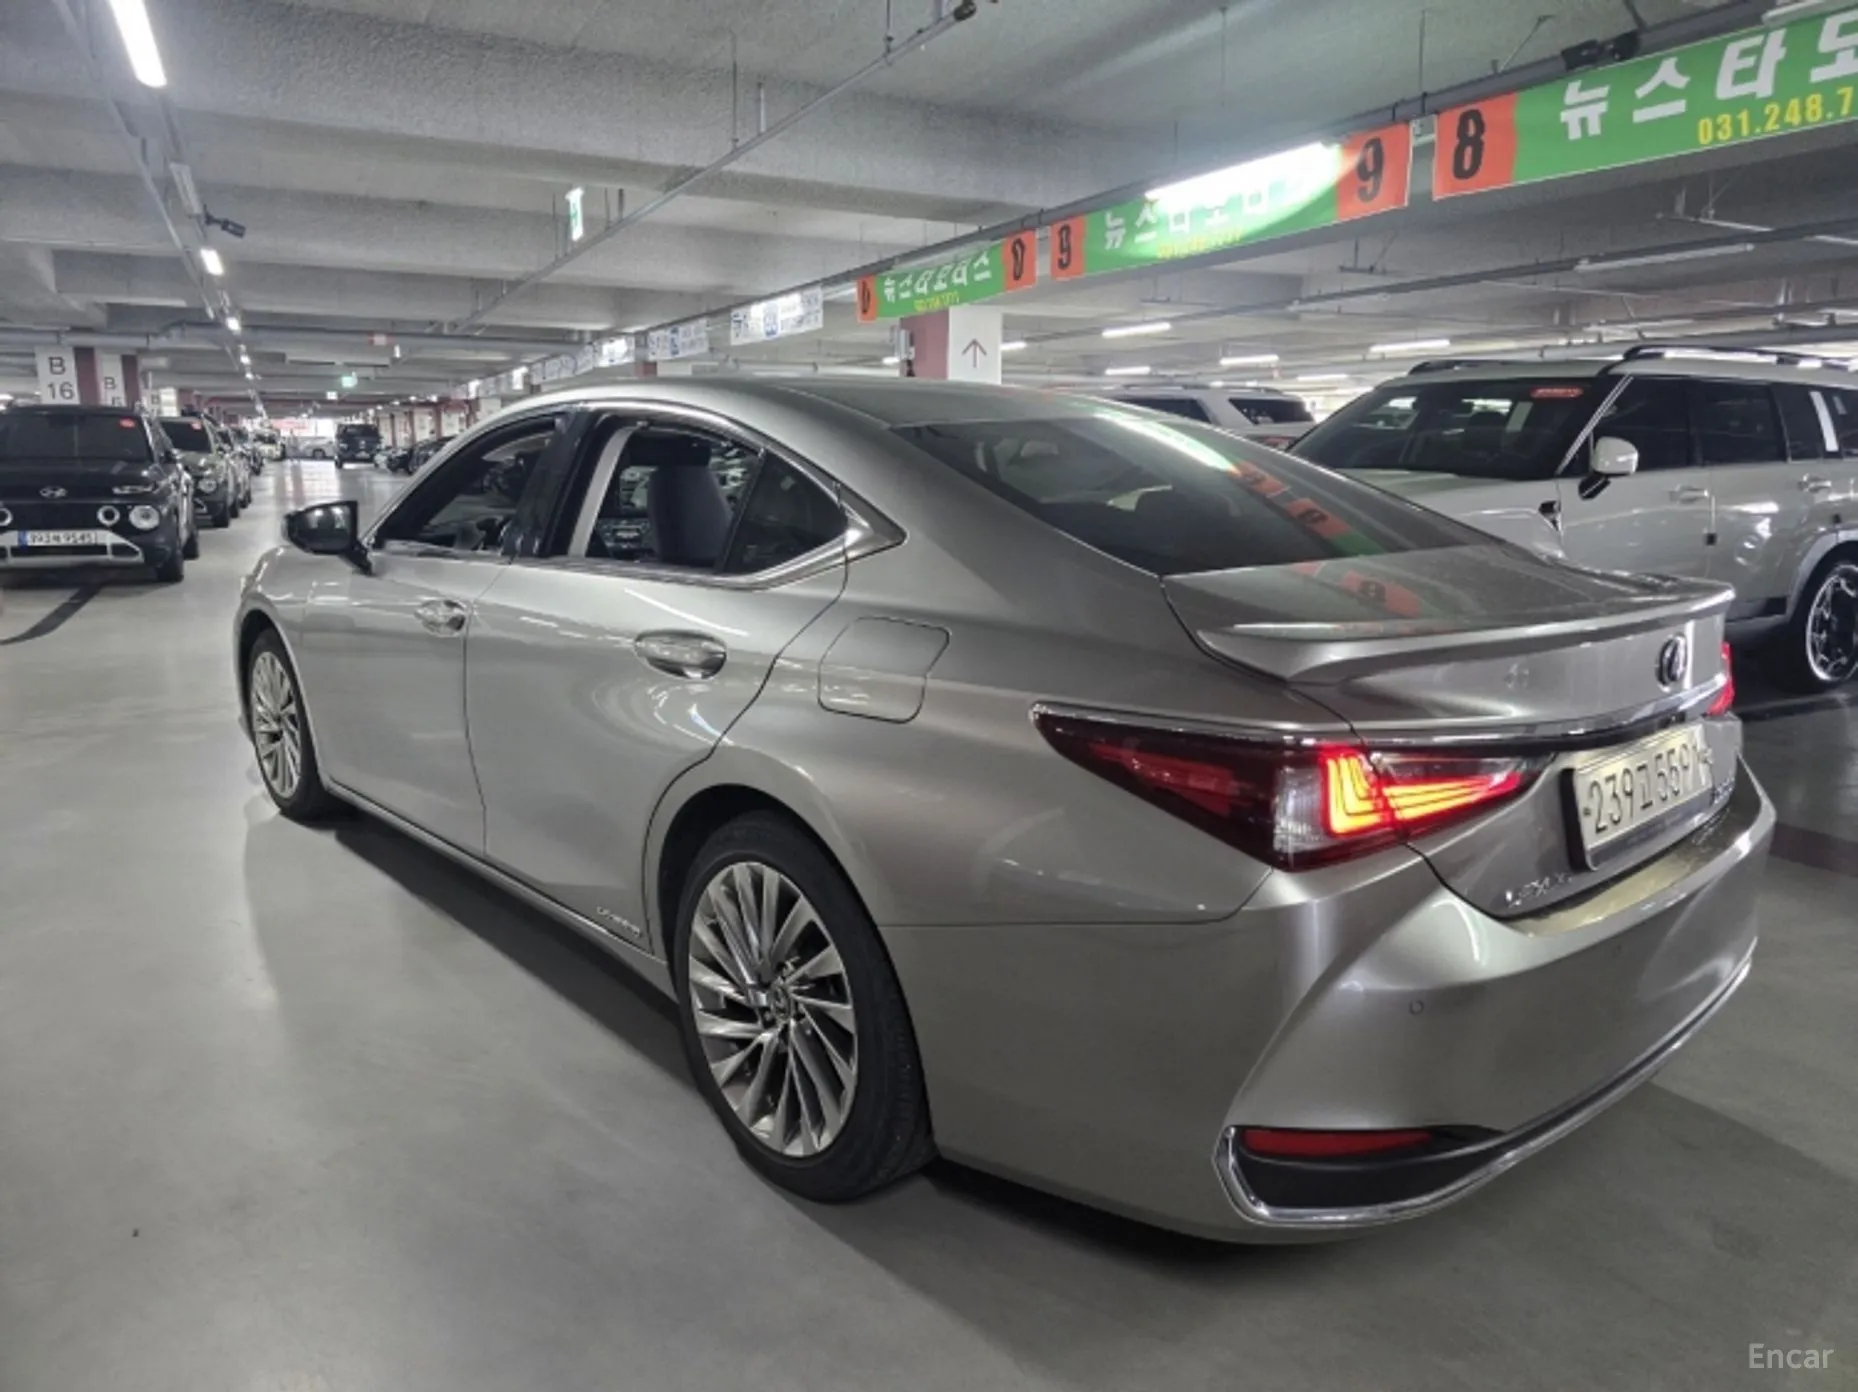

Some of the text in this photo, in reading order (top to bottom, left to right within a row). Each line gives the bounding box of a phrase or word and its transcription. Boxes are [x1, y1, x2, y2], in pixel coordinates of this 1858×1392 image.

[1453, 109, 1486, 180] 8
[1356, 135, 1384, 203] 9
[1056, 223, 1072, 270] 9
[48, 356, 66, 375] B
[47, 381, 75, 400] 16
